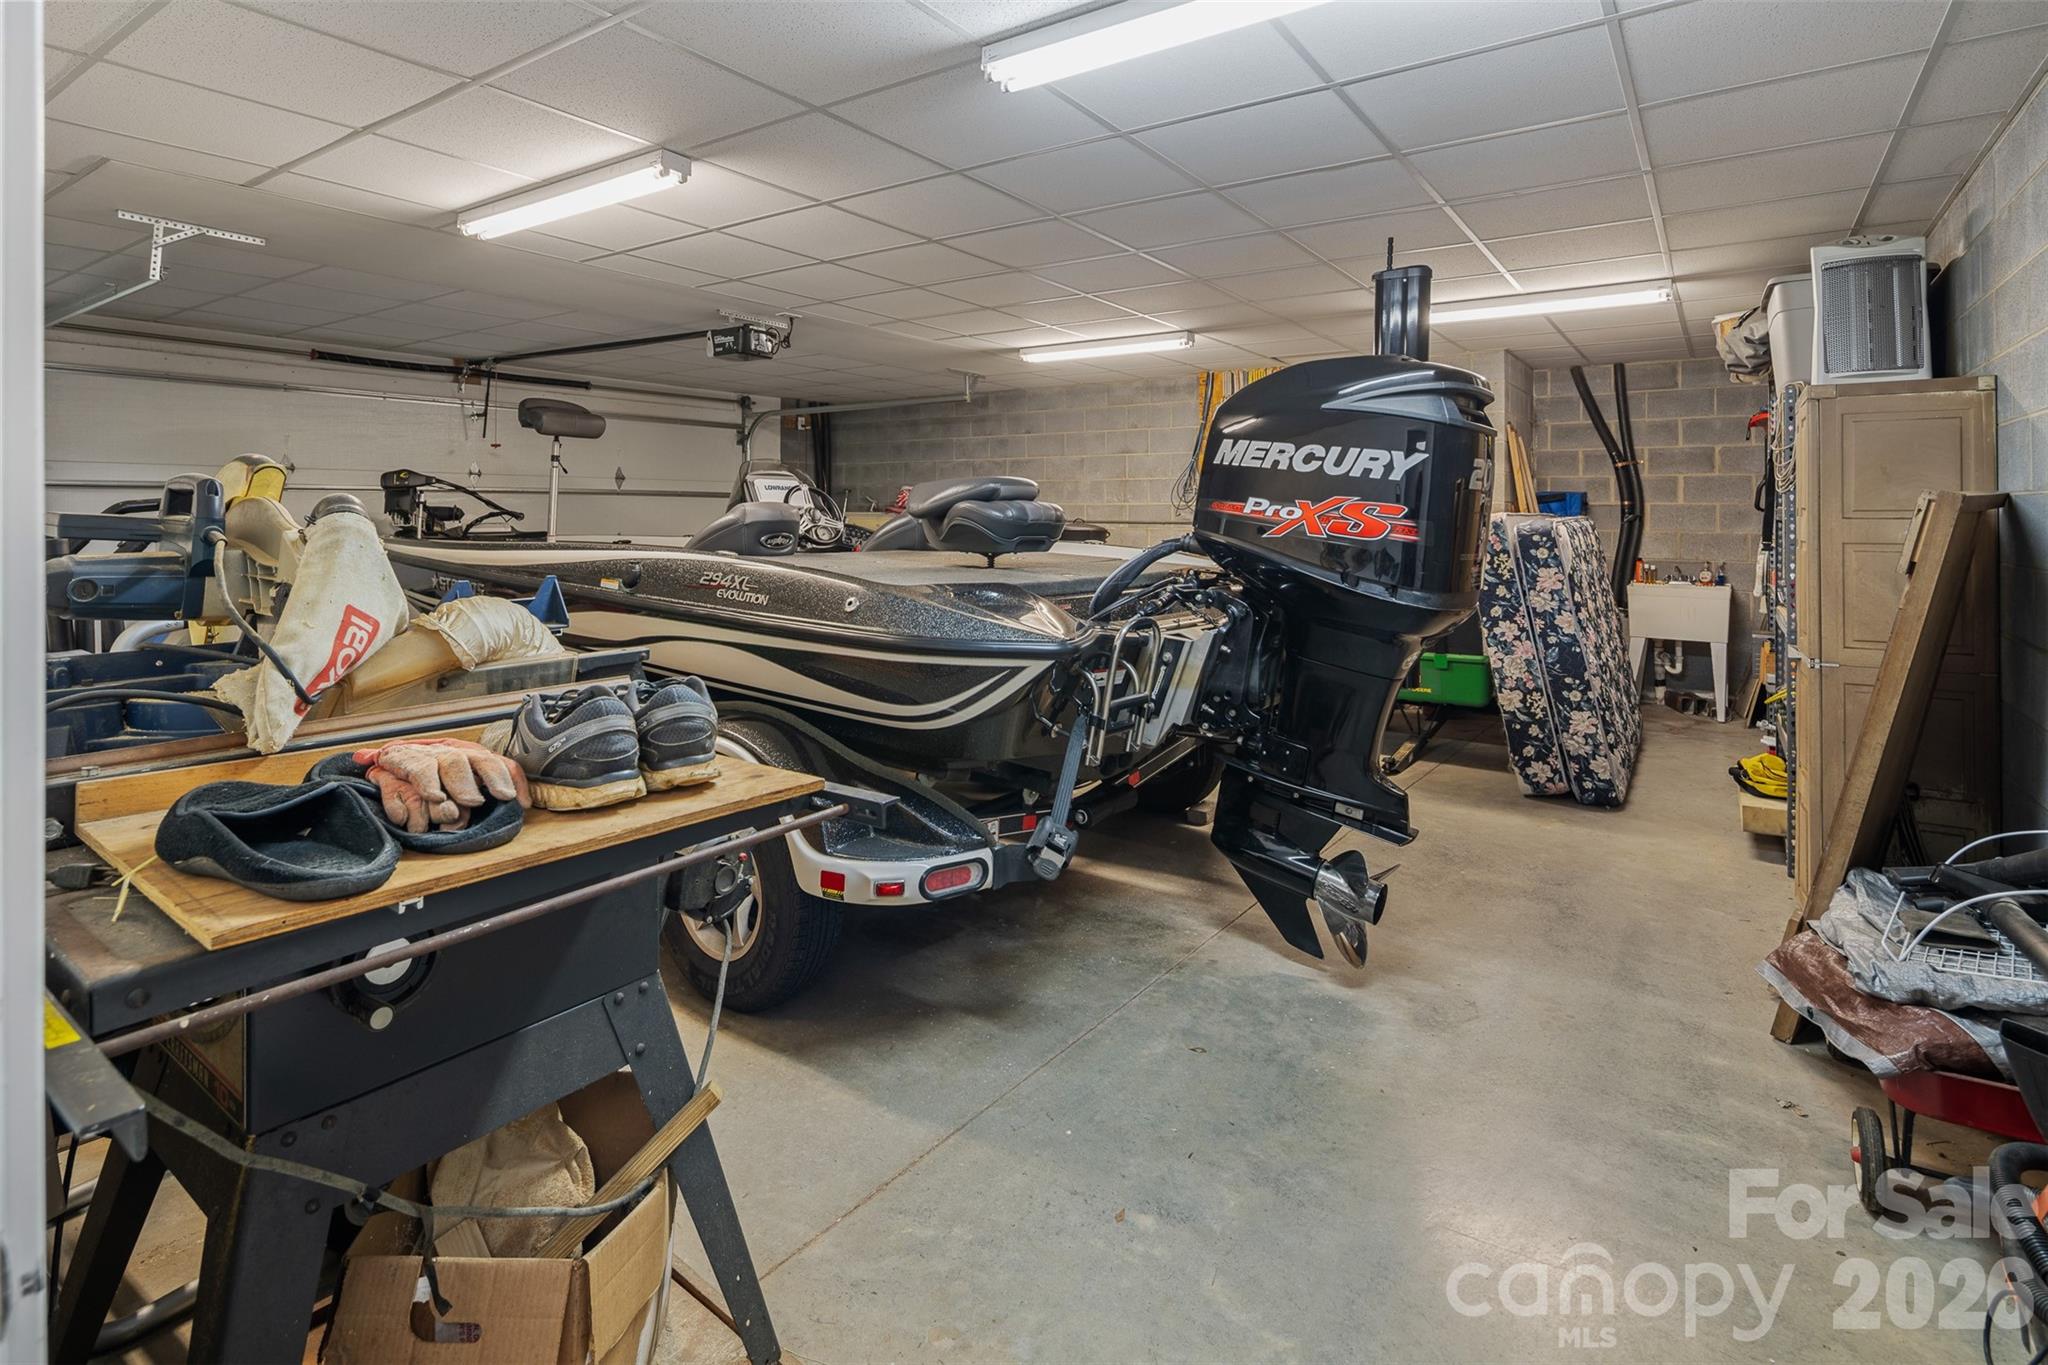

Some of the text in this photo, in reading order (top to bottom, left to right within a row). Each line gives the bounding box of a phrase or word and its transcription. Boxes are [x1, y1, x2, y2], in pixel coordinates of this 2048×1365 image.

[1213, 439, 1429, 481] MERCURY
[700, 571, 758, 591] 294XL
[716, 589, 770, 606] EVOLUTION
